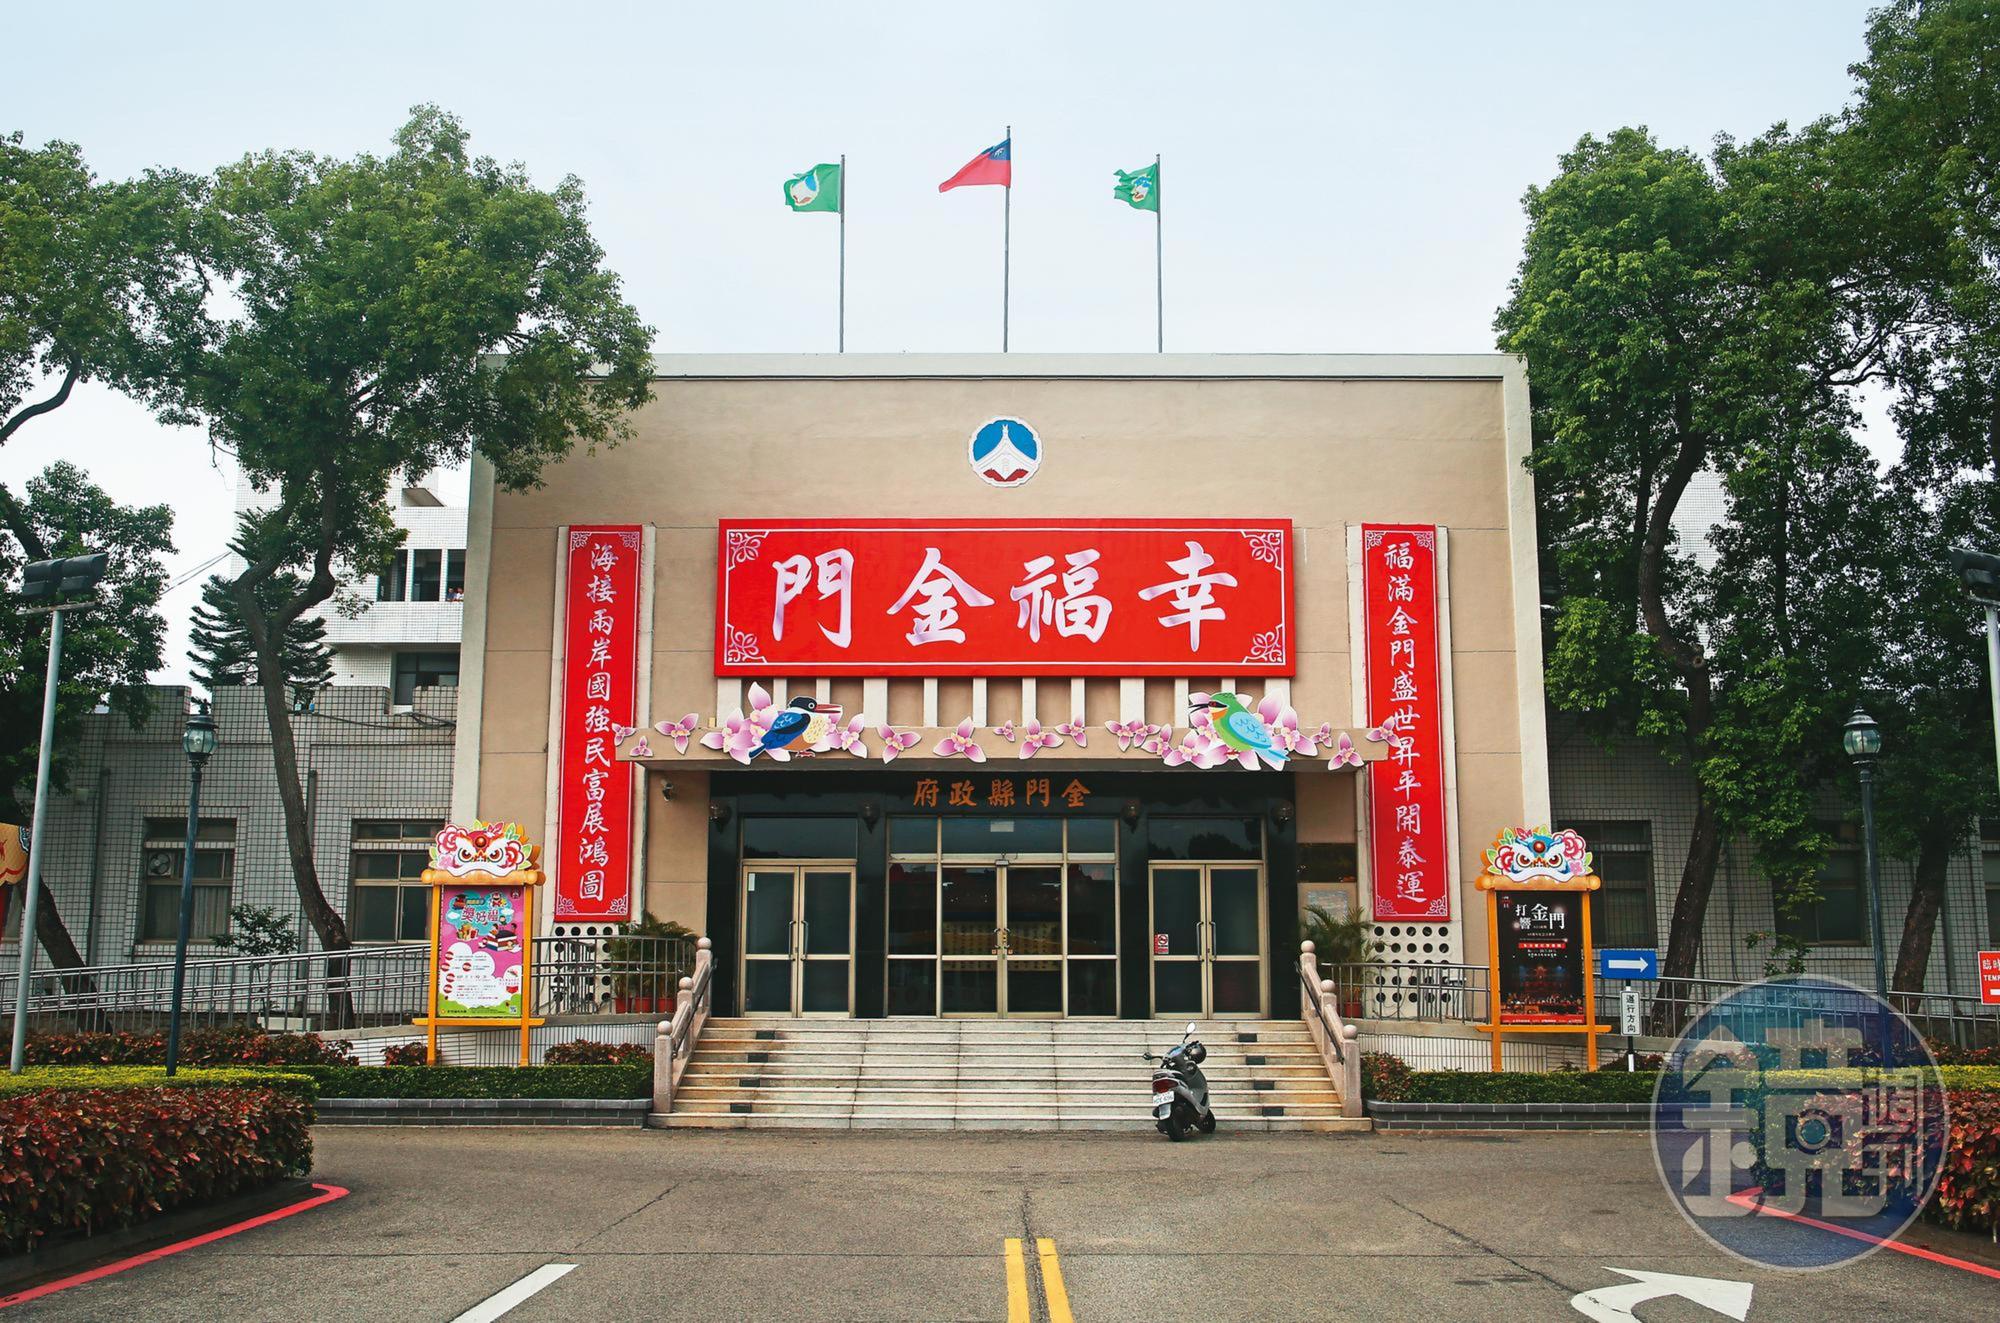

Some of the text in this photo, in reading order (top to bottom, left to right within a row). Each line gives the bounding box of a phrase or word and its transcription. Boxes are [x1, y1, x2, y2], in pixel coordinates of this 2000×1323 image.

[772, 541, 1238, 652] 幸福金門
[579, 543, 619, 902] 海接兩岸國強民富展鴻圖
[913, 778, 1091, 808] 金門縣政府
